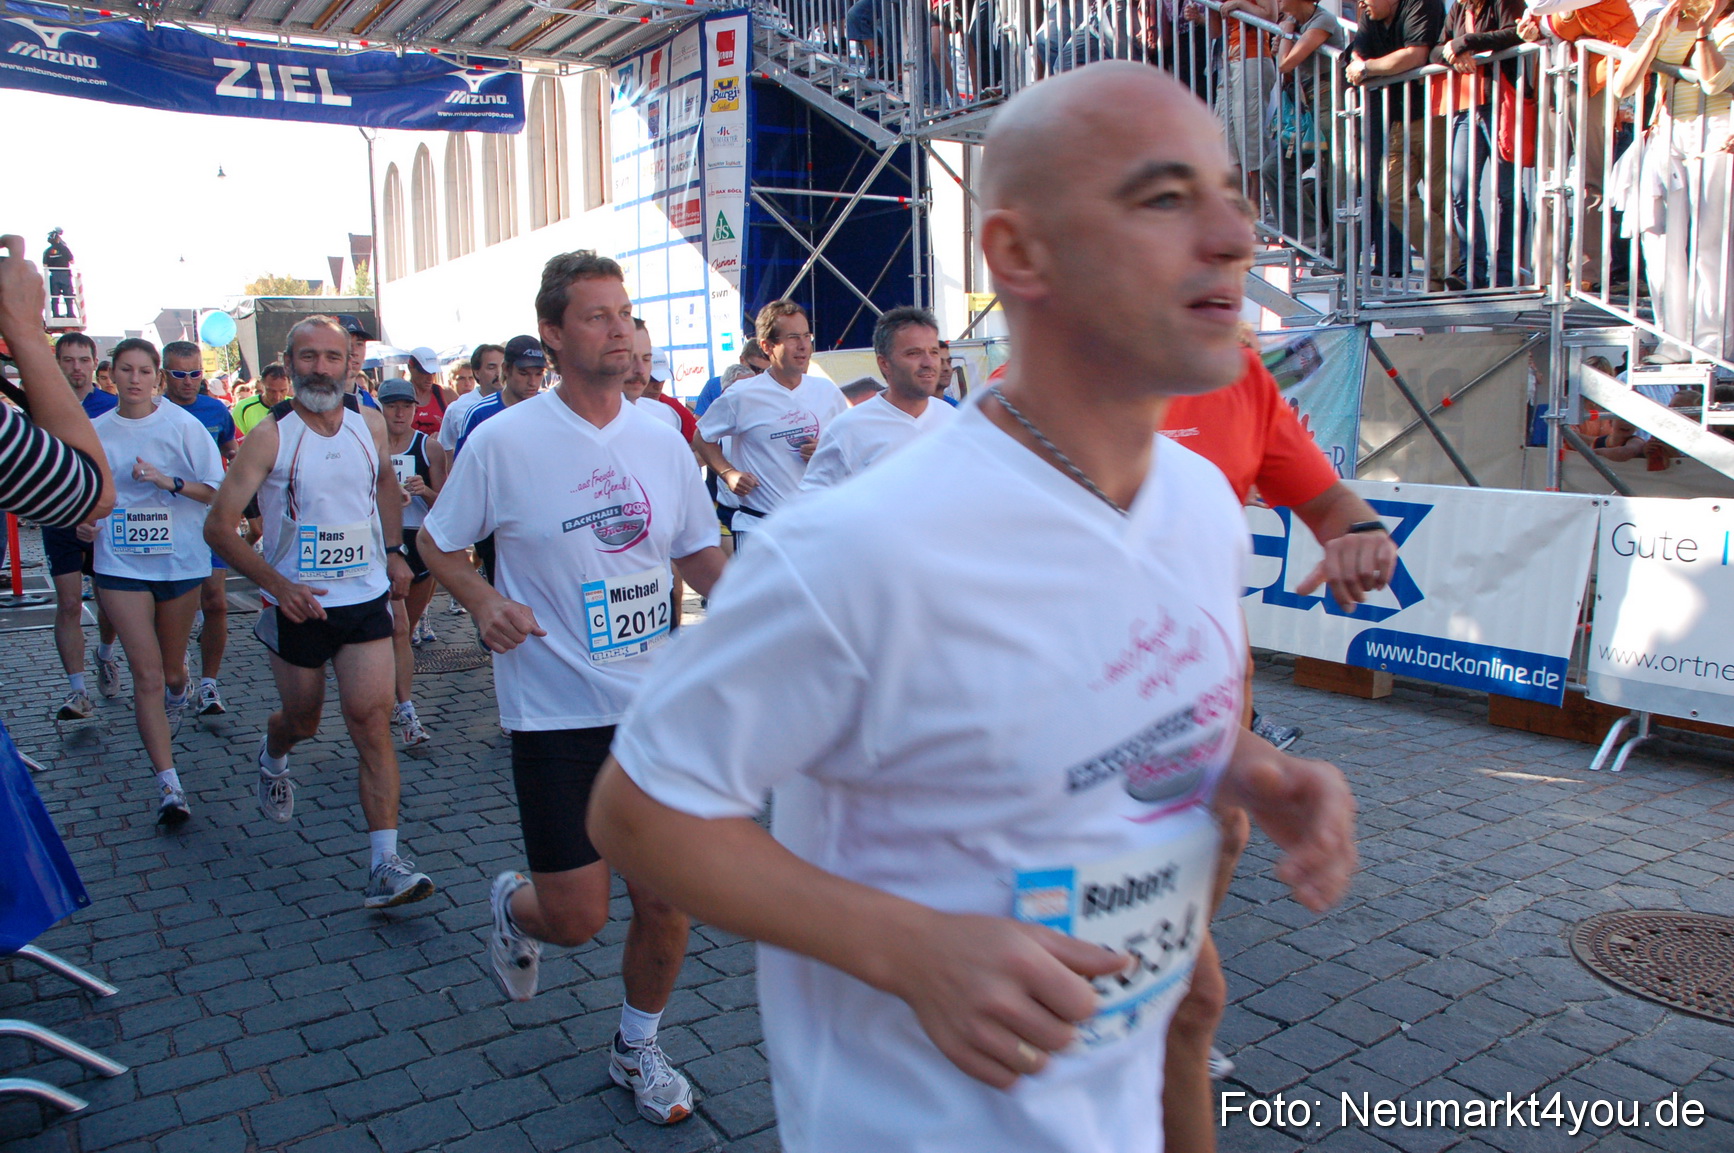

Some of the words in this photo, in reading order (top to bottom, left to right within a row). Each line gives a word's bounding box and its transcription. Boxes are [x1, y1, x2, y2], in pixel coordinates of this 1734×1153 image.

[213, 57, 352, 107] ZIEL
[126, 512, 168, 522] Katharina
[565, 507, 620, 530] BACKHAUS
[116, 525, 123, 533] B
[128, 527, 170, 542] 2922
[319, 532, 345, 541] Hans
[303, 546, 312, 555] A
[1611, 522, 1699, 563] Gute
[320, 545, 364, 565] 2291
[609, 578, 659, 604] Michael
[593, 614, 605, 628] C
[615, 601, 668, 639] 2012
[1366, 640, 1561, 690] www.bockonline.de
